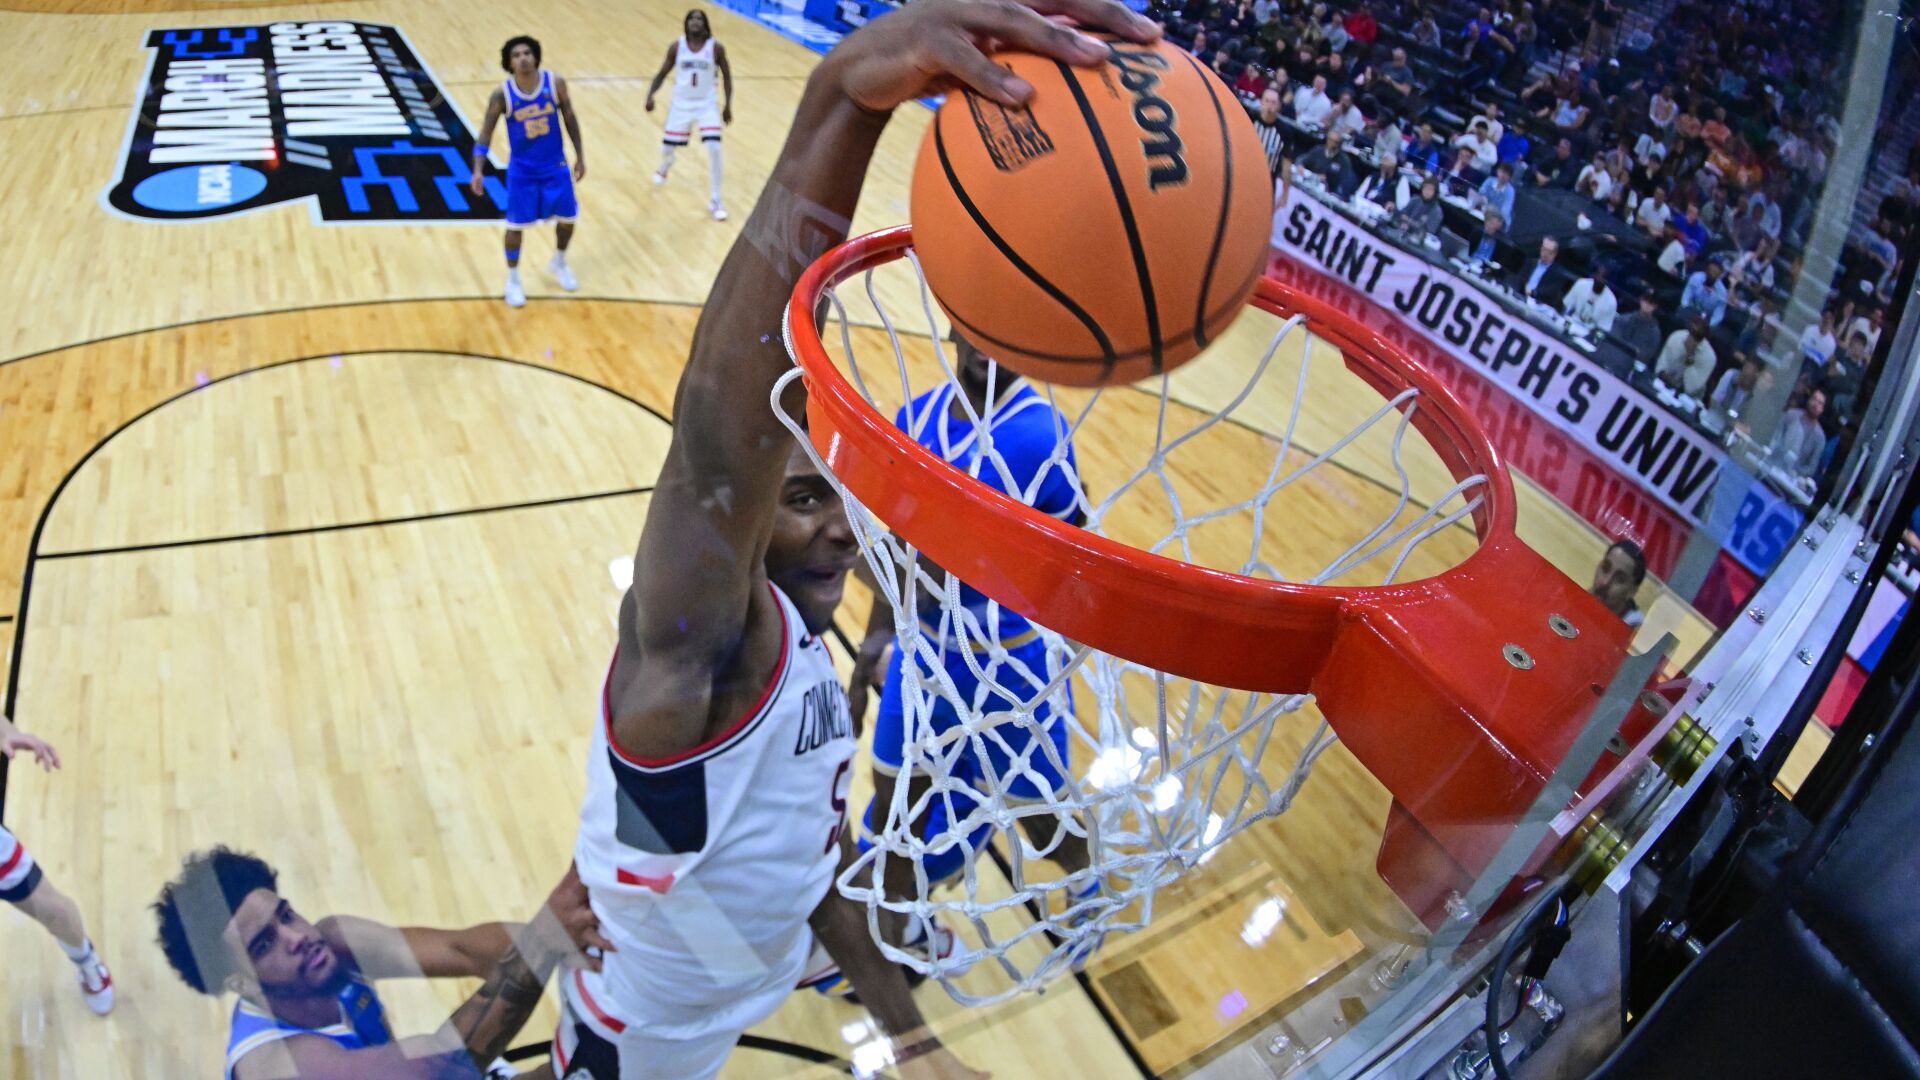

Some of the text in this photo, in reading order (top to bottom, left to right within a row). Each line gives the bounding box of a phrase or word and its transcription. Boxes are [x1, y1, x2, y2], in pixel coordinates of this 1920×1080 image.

[148, 57, 277, 164] MARCH
[268, 21, 411, 136] MADNESS
[513, 102, 554, 122] UCLA
[1104, 42, 1187, 192] lson
[197, 164, 232, 204] NCAA
[1283, 203, 1395, 293] SAINT
[1394, 272, 1600, 424] JOSEPH'S
